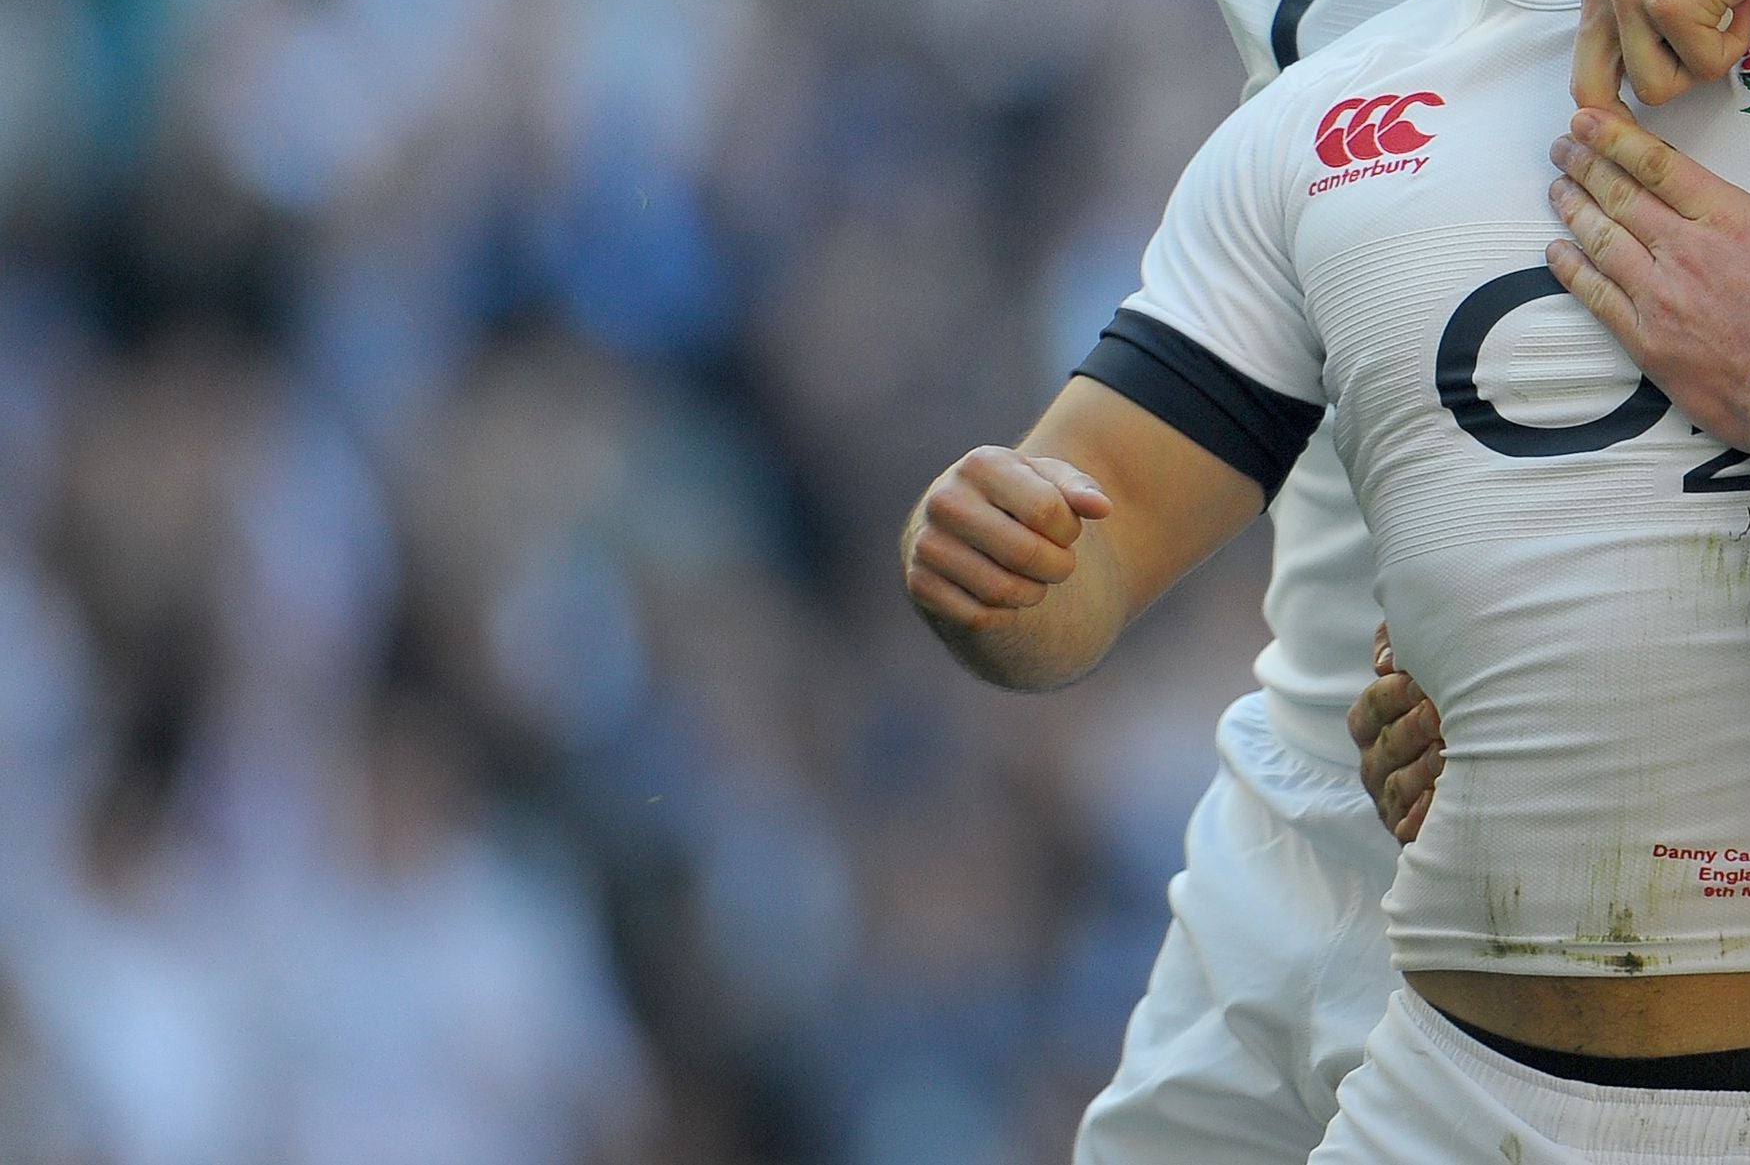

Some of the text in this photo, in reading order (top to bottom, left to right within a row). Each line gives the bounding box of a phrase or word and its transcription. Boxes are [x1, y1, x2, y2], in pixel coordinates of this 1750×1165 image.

[1308, 156, 1430, 197] canterbury
[1652, 844, 1717, 864] Danny
[1704, 883, 1734, 898] 9th
